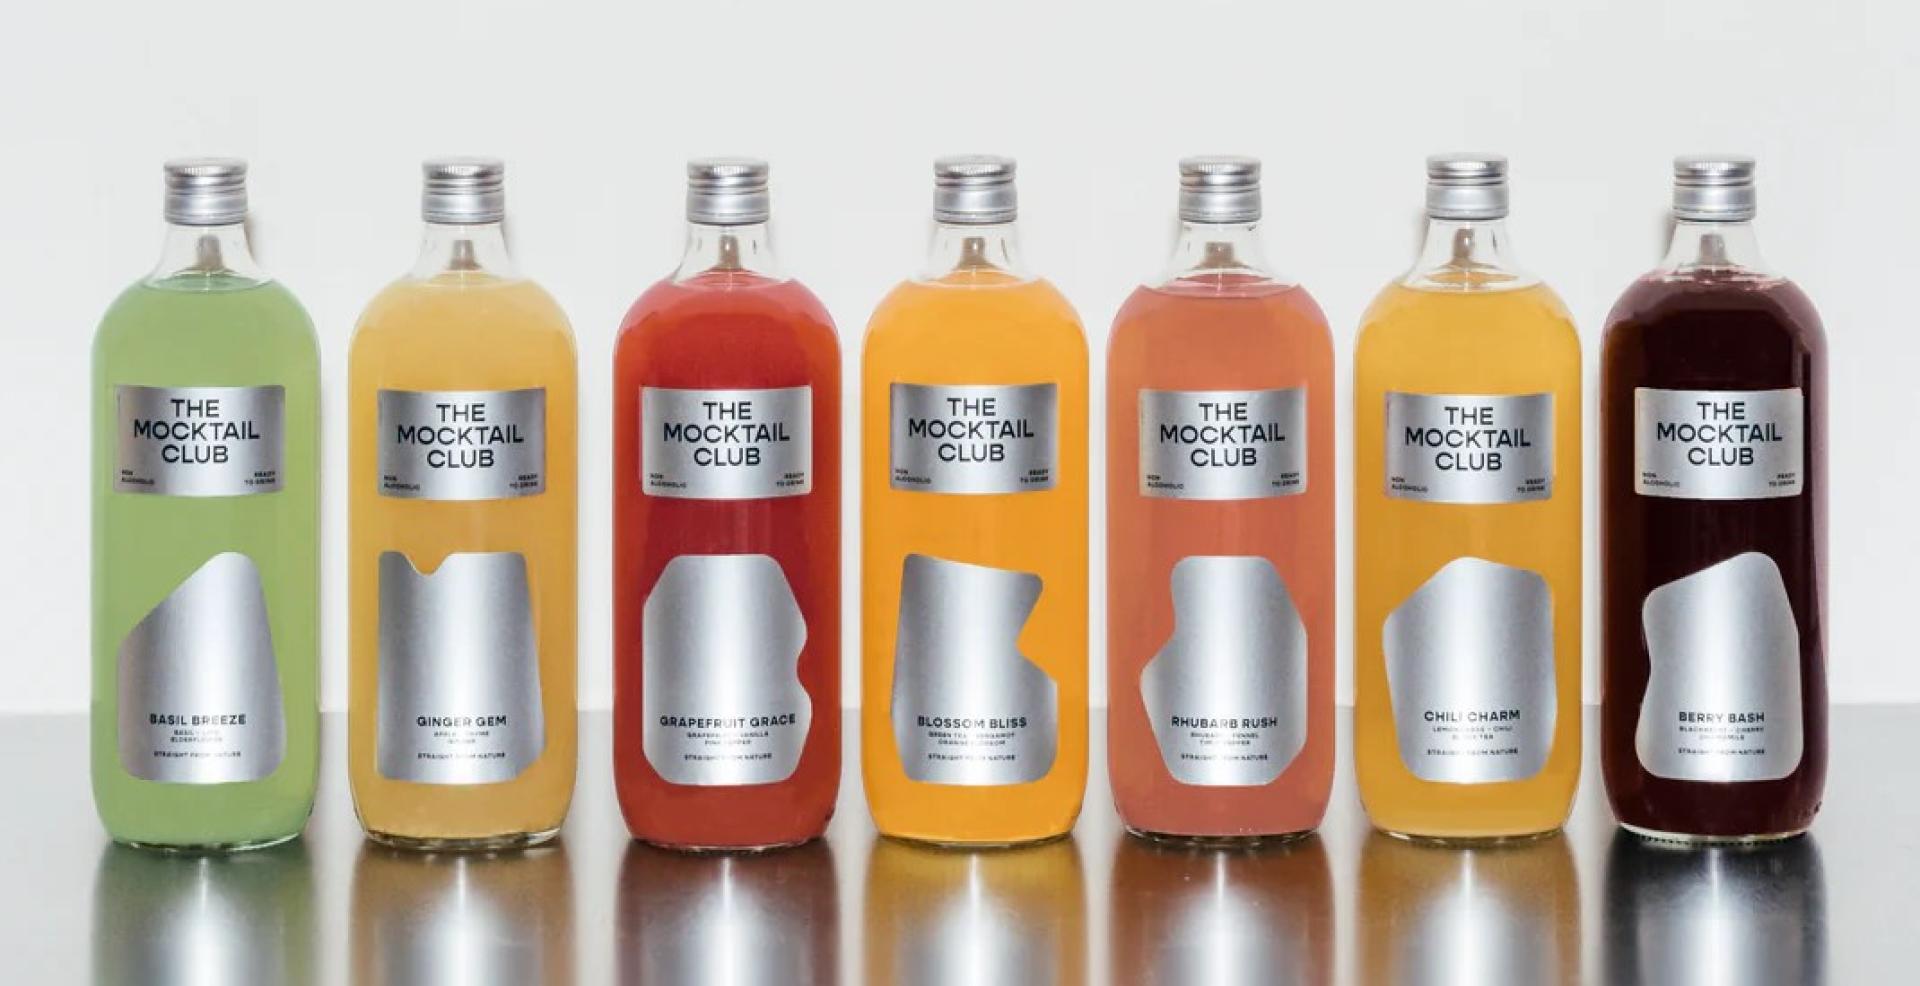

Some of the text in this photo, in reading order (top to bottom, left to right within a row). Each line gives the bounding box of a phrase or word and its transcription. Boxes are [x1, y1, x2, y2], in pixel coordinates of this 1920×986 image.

[171, 399, 219, 417] THE
[436, 403, 485, 421] THE
[703, 402, 752, 419] THE
[947, 398, 996, 416] THE
[1199, 403, 1247, 421] THE
[1445, 407, 1493, 425] THE
[1697, 402, 1744, 420] THE
[134, 419, 260, 440] MOCKTAIL
[398, 425, 524, 444] MOCKTAIL
[664, 423, 790, 442] MOCKTAIL
[909, 419, 1034, 439] MOCKTAIL
[1161, 423, 1285, 444] MOCKTAIL
[1405, 427, 1530, 448] MOCKTAIL
[1658, 423, 1782, 443] MOCKTAIL
[162, 444, 228, 463] CLUB
[427, 450, 494, 468] CLUB
[694, 448, 760, 466] CLUB
[938, 444, 1004, 461] CLUB
[1191, 448, 1256, 466] CLUB
[1436, 452, 1502, 470] CLUB
[1688, 448, 1753, 466] CLUB
[150, 713, 187, 725] BASIL
[418, 716, 506, 726] GINGER GEM
[660, 713, 795, 728] GRAPEFRUIT GRACE
[918, 716, 1027, 728] BLOSSOM BLISS
[1172, 716, 1277, 728] RHUBARB RUSH
[1425, 710, 1520, 721] CHILI CHARM
[1679, 712, 1764, 723] BERRY BASH
